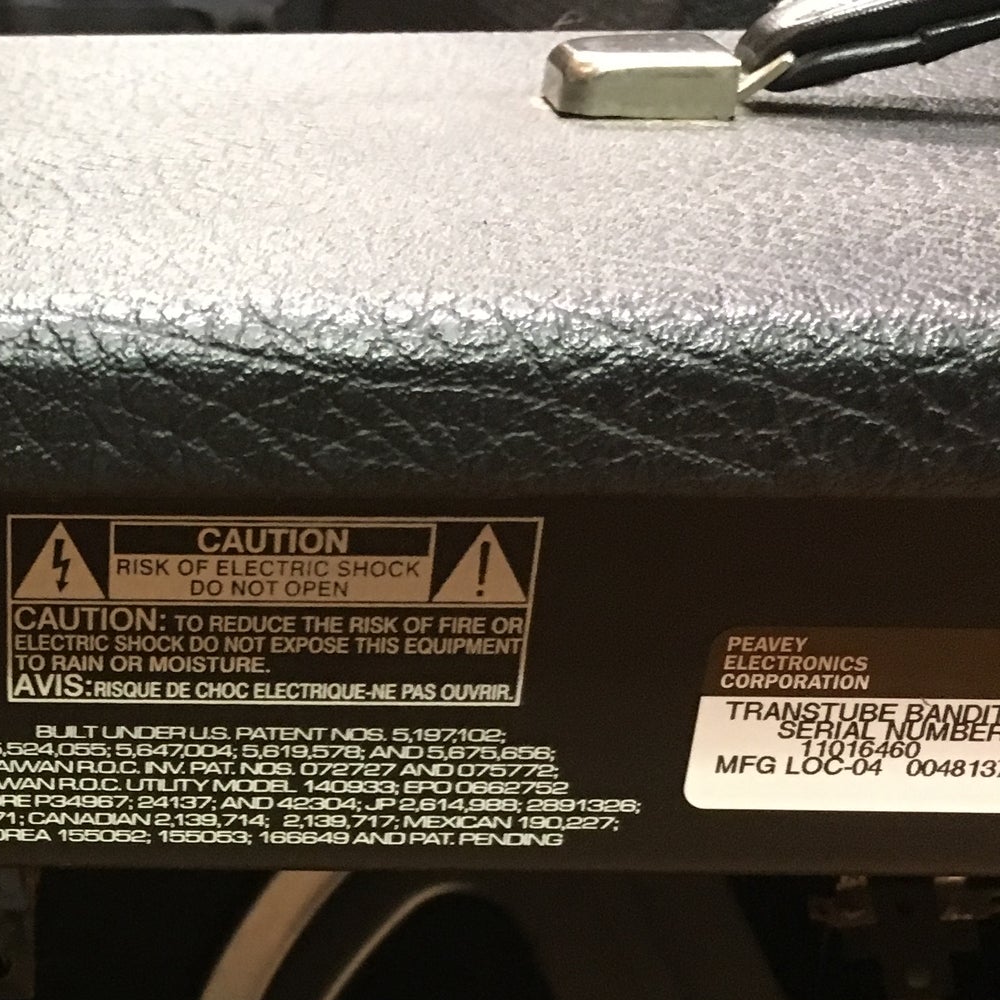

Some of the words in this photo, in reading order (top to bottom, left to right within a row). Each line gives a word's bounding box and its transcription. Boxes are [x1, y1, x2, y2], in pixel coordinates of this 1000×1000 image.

[197, 527, 349, 554] CAUTION
[116, 558, 170, 576] RISK
[177, 559, 210, 576] OF
[215, 559, 329, 578] ELECTRIC
[337, 560, 420, 578] SHOCK
[190, 579, 224, 597] DO
[231, 580, 279, 597] NOT
[284, 580, 349, 597] OPEN
[13, 606, 167, 632] CAUTION:
[174, 614, 205, 633] TO
[209, 615, 297, 633] REDUCE
[301, 615, 344, 634] THE
[349, 616, 399, 634] RISK
[402, 616, 435, 634] OF
[438, 617, 487, 634] FIRE
[490, 616, 524, 635] OR
[14, 634, 109, 651] ELECTRIC
[114, 635, 185, 652] SHOCK
[188, 635, 219, 652] DO
[224, 636, 267, 653] NOT
[270, 636, 350, 654] EXPOSE
[355, 637, 400, 654] THIS
[404, 637, 524, 656] EQUIPMENT
[727, 635, 808, 653] PEAVEY
[15, 654, 46, 671] TO
[51, 654, 104, 672] RAIN
[109, 655, 144, 673] OR
[149, 655, 272, 674] MOISTURE.
[723, 654, 869, 672] ELECTRONICS
[166, 681, 191, 699] DE
[195, 682, 250, 699] CHOC
[401, 683, 437, 700] PAS
[440, 683, 514, 702] OUVRIR.
[720, 673, 870, 691] CORPORATION
[726, 701, 899, 723] TRANSTUBE
[35, 724, 99, 739] BUILT
[102, 725, 187, 740] UNDER
[189, 726, 231, 741] U.S.
[235, 726, 329, 741] PATENT
[330, 727, 388, 742] NOS.
[391, 727, 507, 745] 5,197,102;
[777, 719, 876, 741] SERIAL
[115, 742, 238, 760] 5,647,004;
[241, 744, 366, 761] 5,619,578;
[368, 745, 425, 760] AND
[426, 746, 557, 762] 5,675,656;
[801, 739, 922, 759] 11016460
[76, 760, 141, 775] R.O.C.
[144, 761, 186, 775] INV.
[189, 761, 237, 776] PAT.
[239, 762, 297, 776] NOS.
[299, 762, 398, 777] 072727
[399, 763, 455, 777] AND
[456, 763, 560, 780] 075772;
[714, 754, 777, 775] MFG
[784, 756, 883, 777] LOC-04
[906, 758, 1000, 779] 004813
[58, 777, 122, 792] R.O.C.
[125, 778, 210, 793] UTILITY
[211, 779, 298, 794] MODEL
[303, 779, 401, 796] 140933;
[403, 780, 453, 795] EPO
[454, 780, 570, 795] 0662752
[34, 794, 135, 811] P34967;
[136, 795, 218, 812] 24137;
[219, 796, 275, 811] AND
[276, 797, 363, 813] 42304;
[364, 797, 397, 812] JP
[398, 798, 523, 814] 2,614,988;
[525, 798, 642, 816] 2891326;
[27, 811, 152, 827] CANADIAN
[153, 812, 271, 829] 2,139,714;
[282, 814, 401, 830] 2,139,717;
[402, 815, 513, 829] MEXICAN
[517, 816, 620, 832] 190,227;
[56, 828, 152, 845] 155052;
[157, 830, 253, 846] 155053;
[258, 830, 350, 845] 166649
[351, 831, 407, 846] AND
[409, 832, 456, 846] PAT.
[458, 832, 564, 847] PENDING
